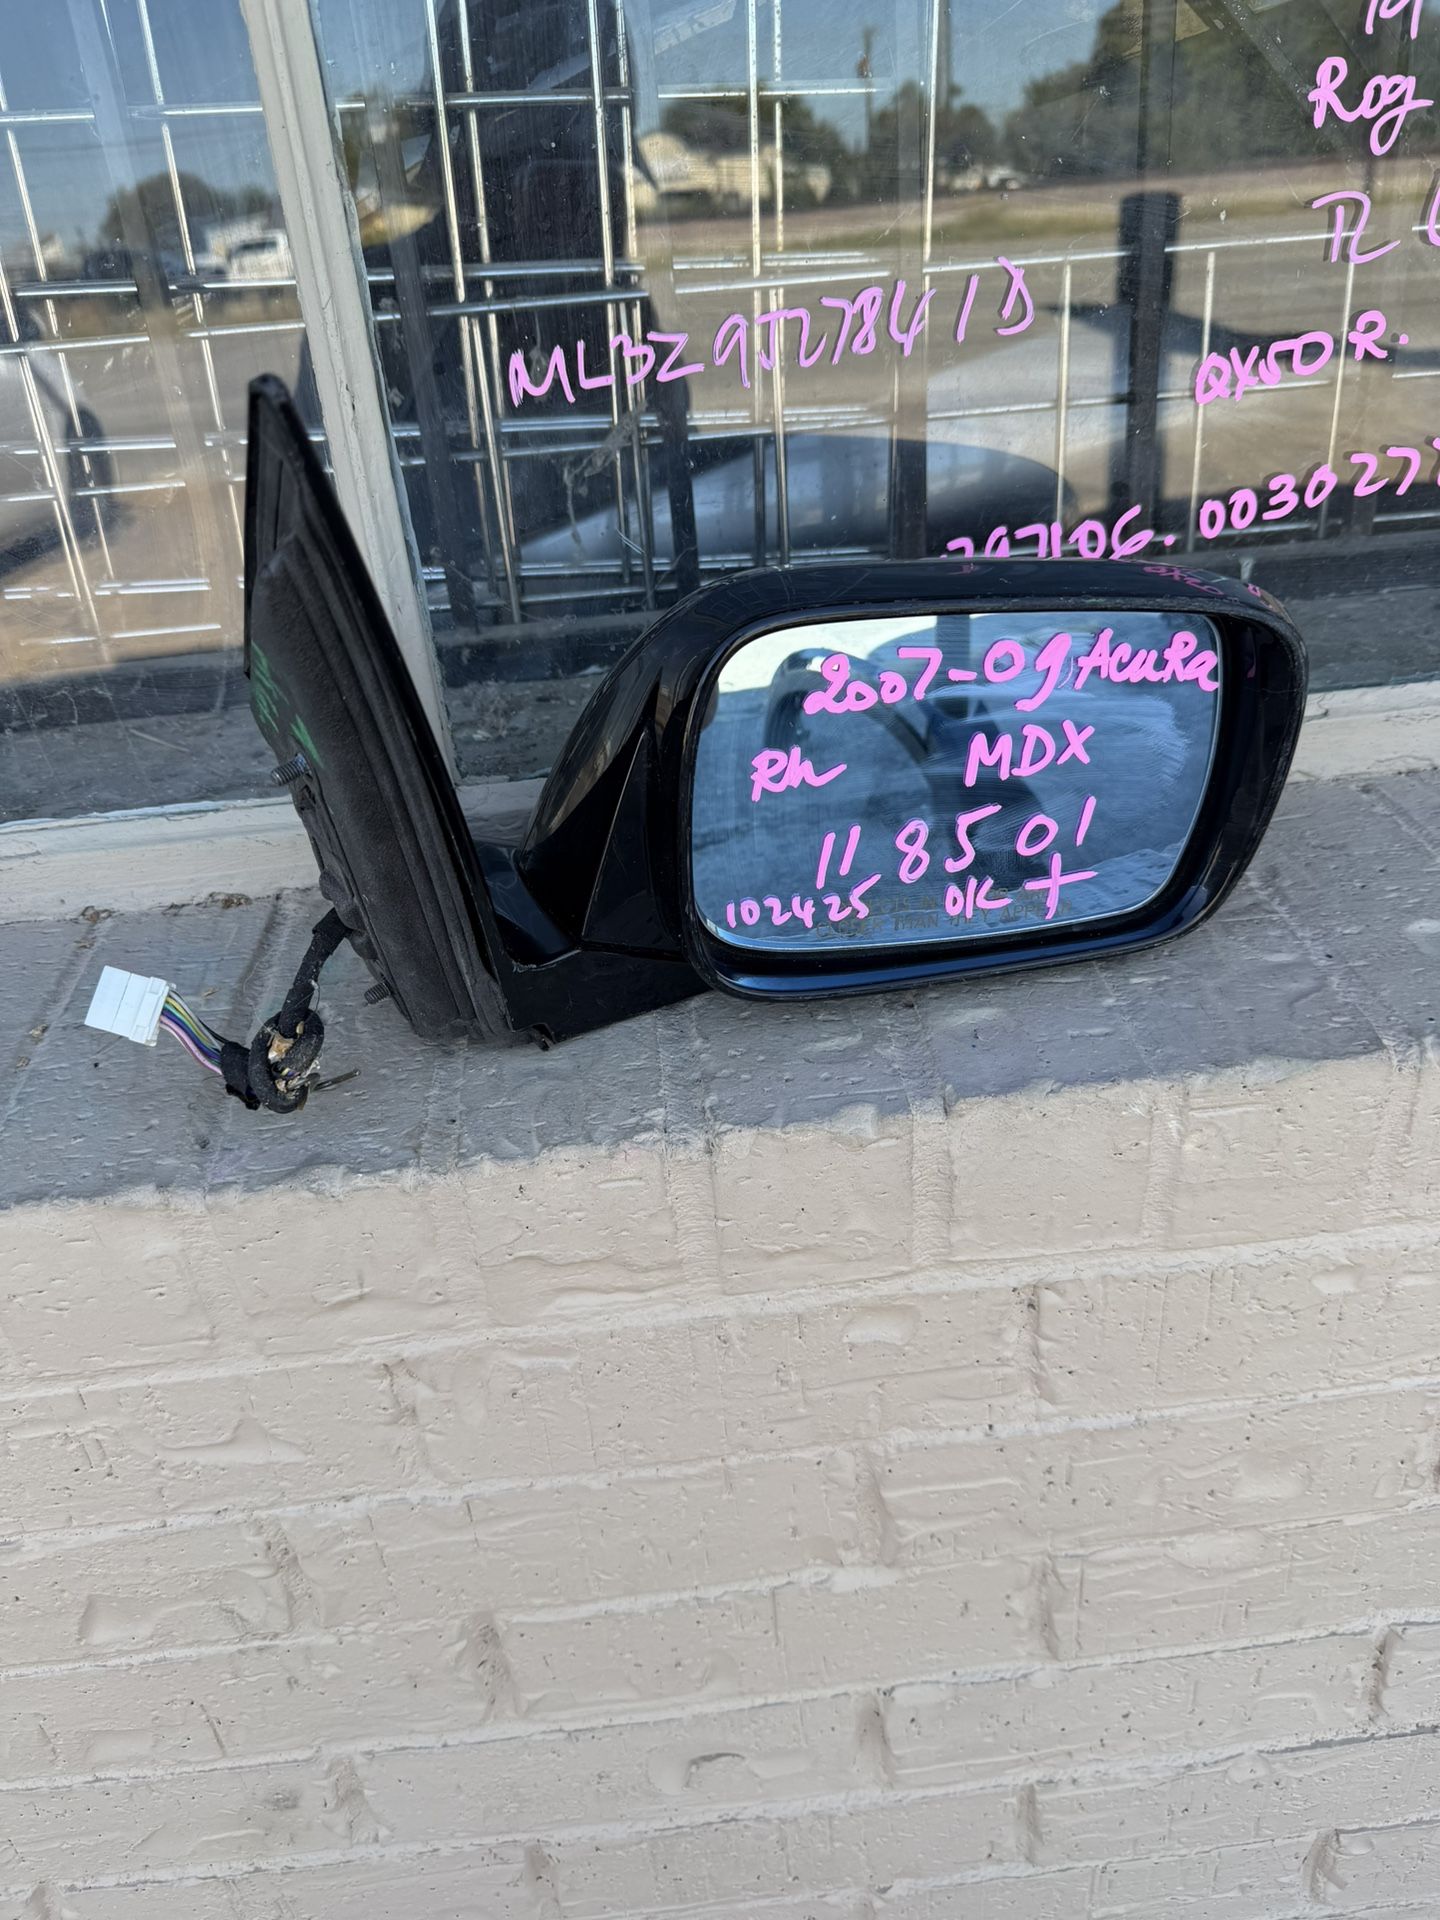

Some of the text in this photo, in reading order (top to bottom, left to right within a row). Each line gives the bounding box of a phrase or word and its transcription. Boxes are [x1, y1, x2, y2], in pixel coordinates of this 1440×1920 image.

[1195, 330, 1334, 405] QX50
[803, 633, 1072, 713] 2007-09
[964, 720, 1095, 787] MDX
[725, 873, 882, 929] 102425
[944, 875, 1014, 919] OK
